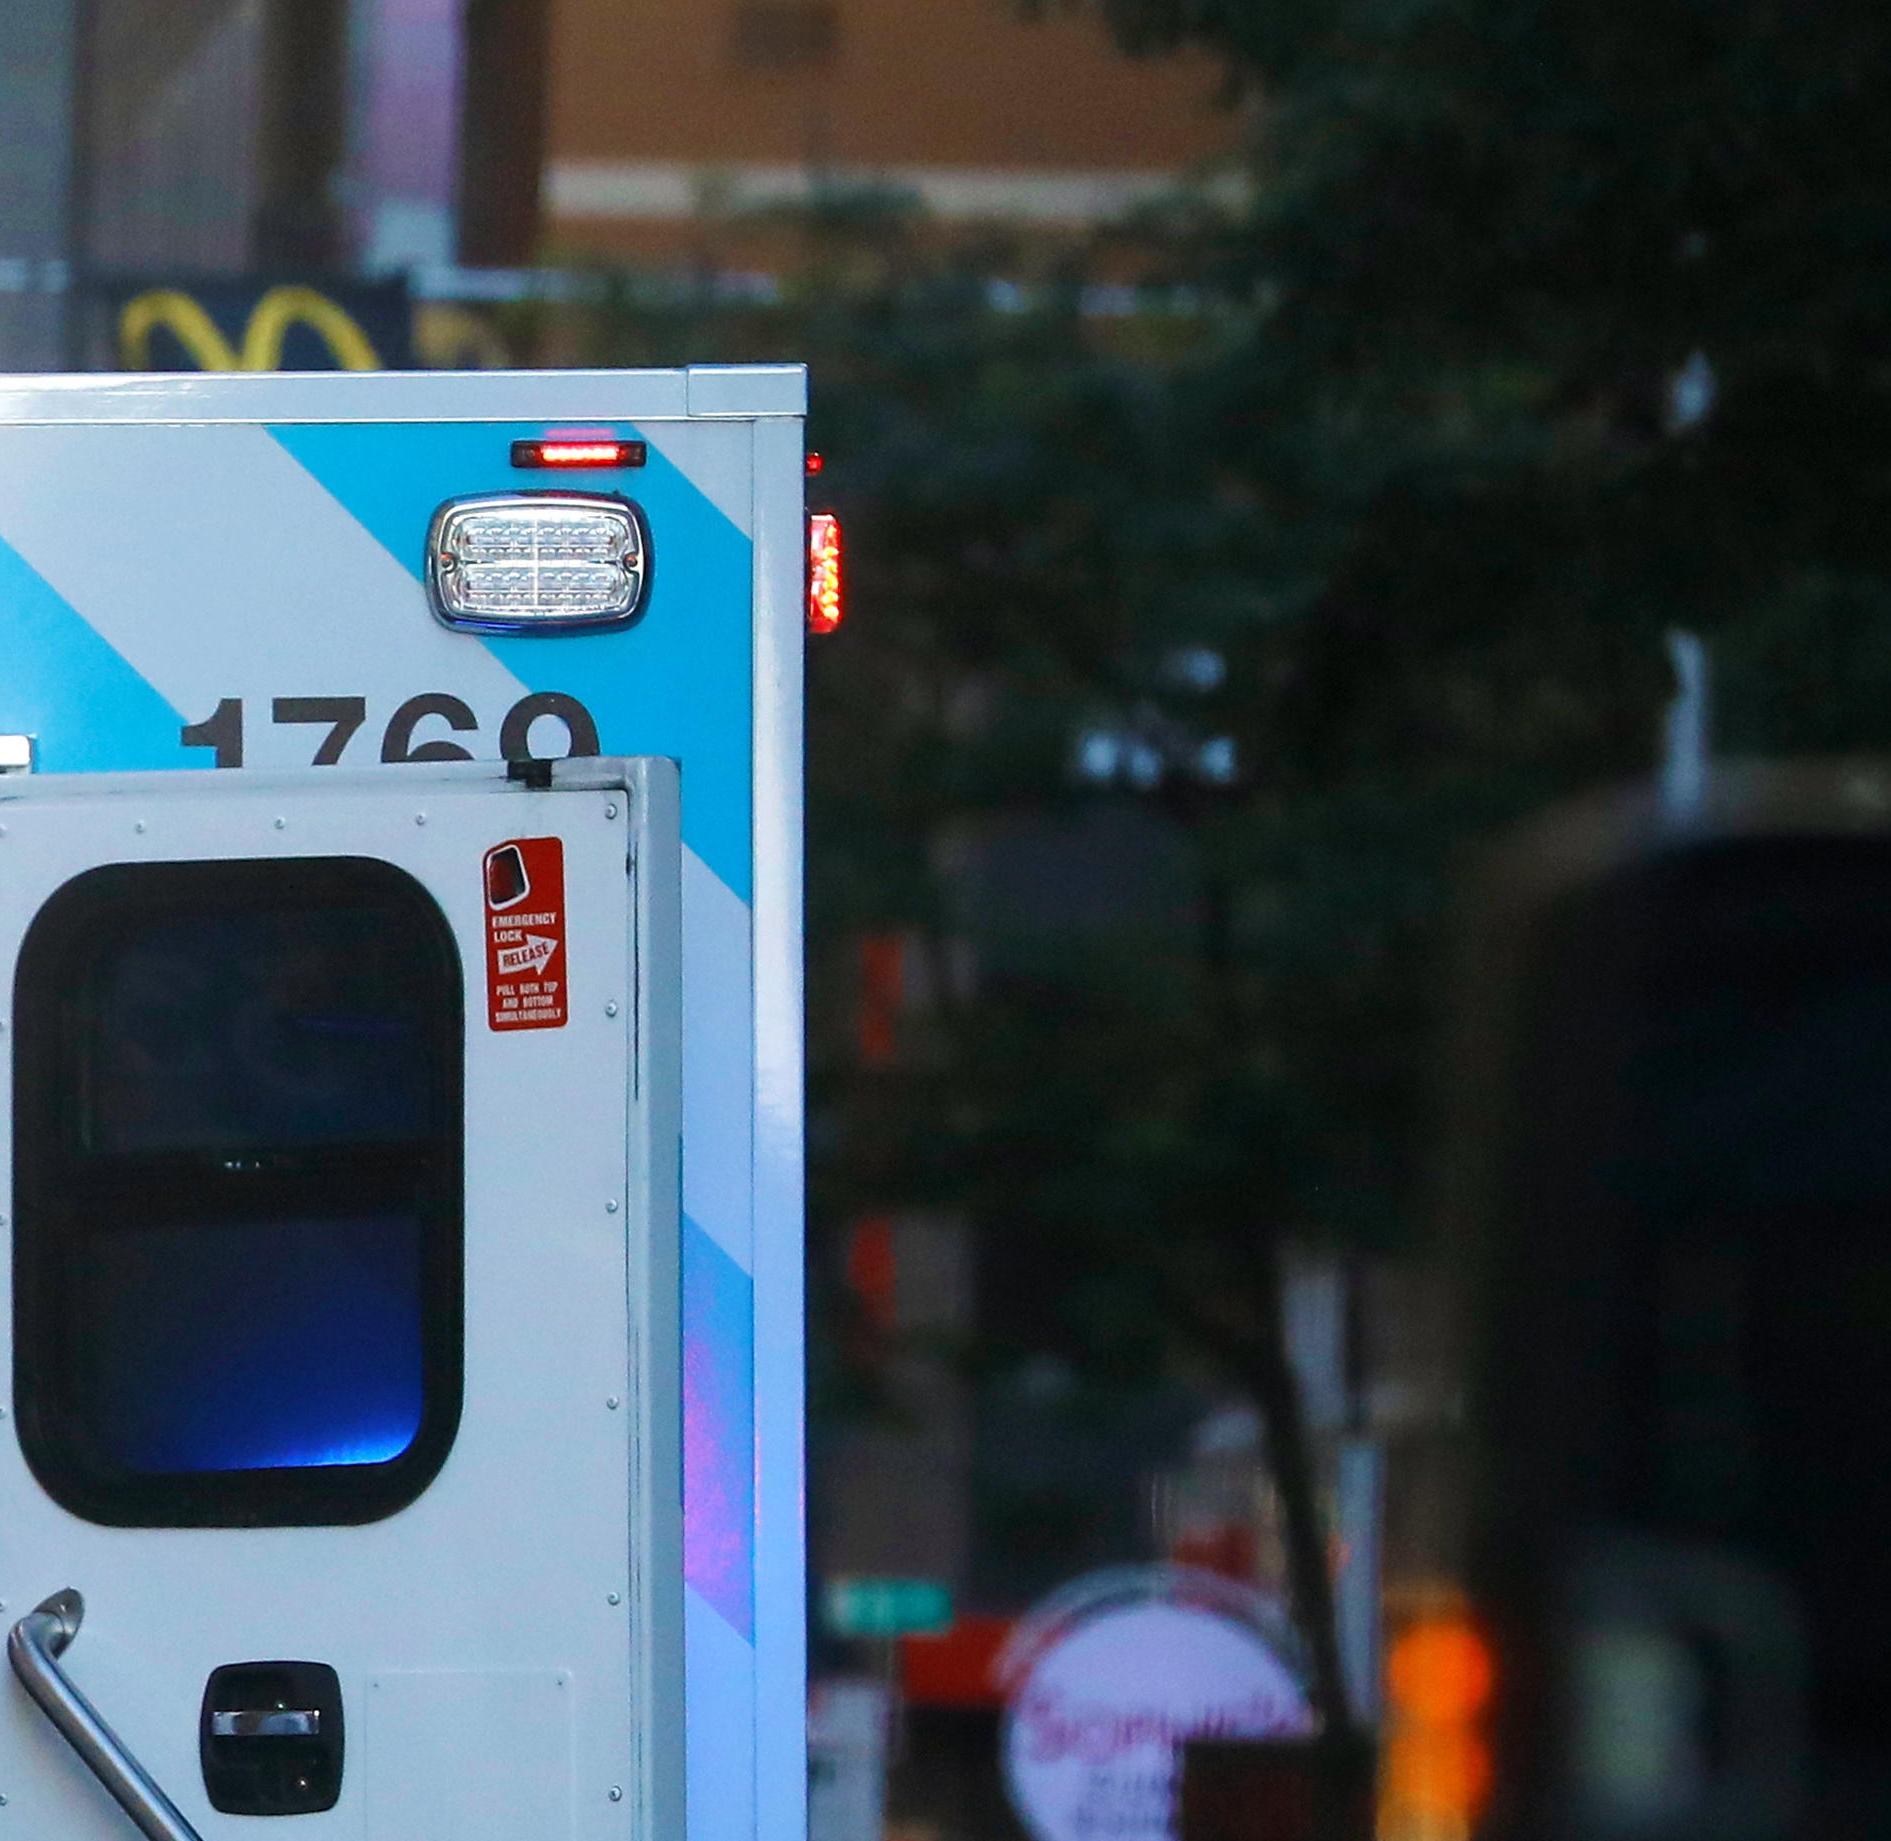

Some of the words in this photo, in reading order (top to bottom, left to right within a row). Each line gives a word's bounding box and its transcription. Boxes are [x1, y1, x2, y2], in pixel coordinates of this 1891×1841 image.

[492, 912, 557, 928] EMERGENCY
[493, 929, 524, 943] LOCK
[502, 941, 550, 967] RELEASE
